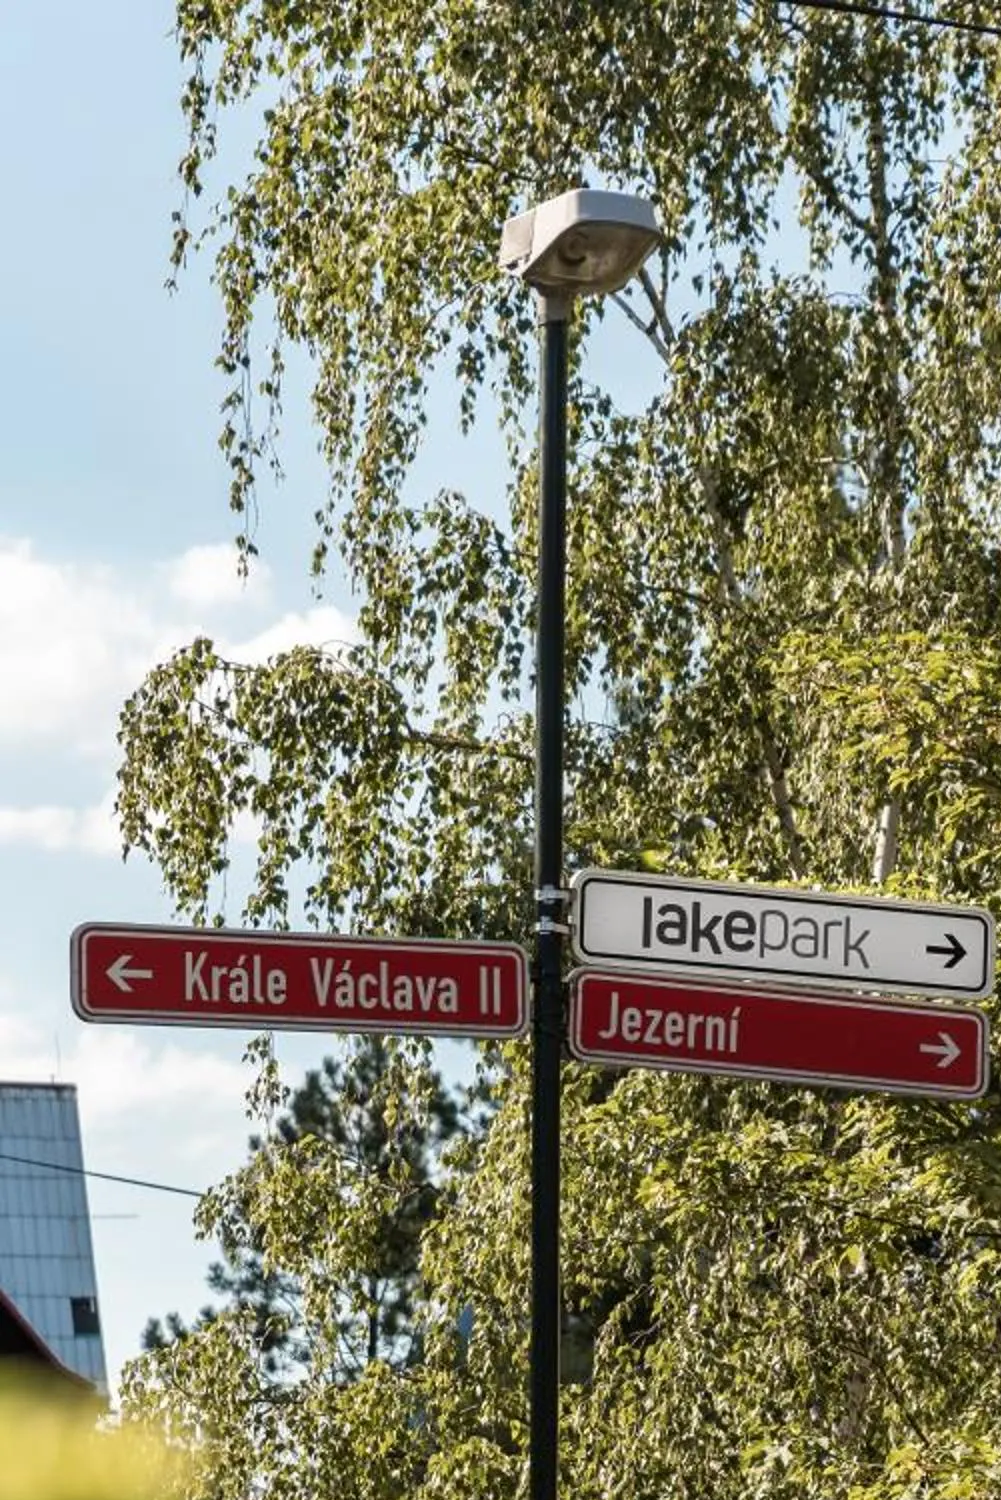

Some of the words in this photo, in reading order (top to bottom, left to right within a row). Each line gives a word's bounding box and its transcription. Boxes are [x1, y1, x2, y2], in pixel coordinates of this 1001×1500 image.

[642, 896, 870, 968] lakepark
[184, 951, 288, 1005] Krále
[310, 957, 459, 1013] Václava
[479, 965, 501, 1016] II
[599, 991, 741, 1052] Jezerní
